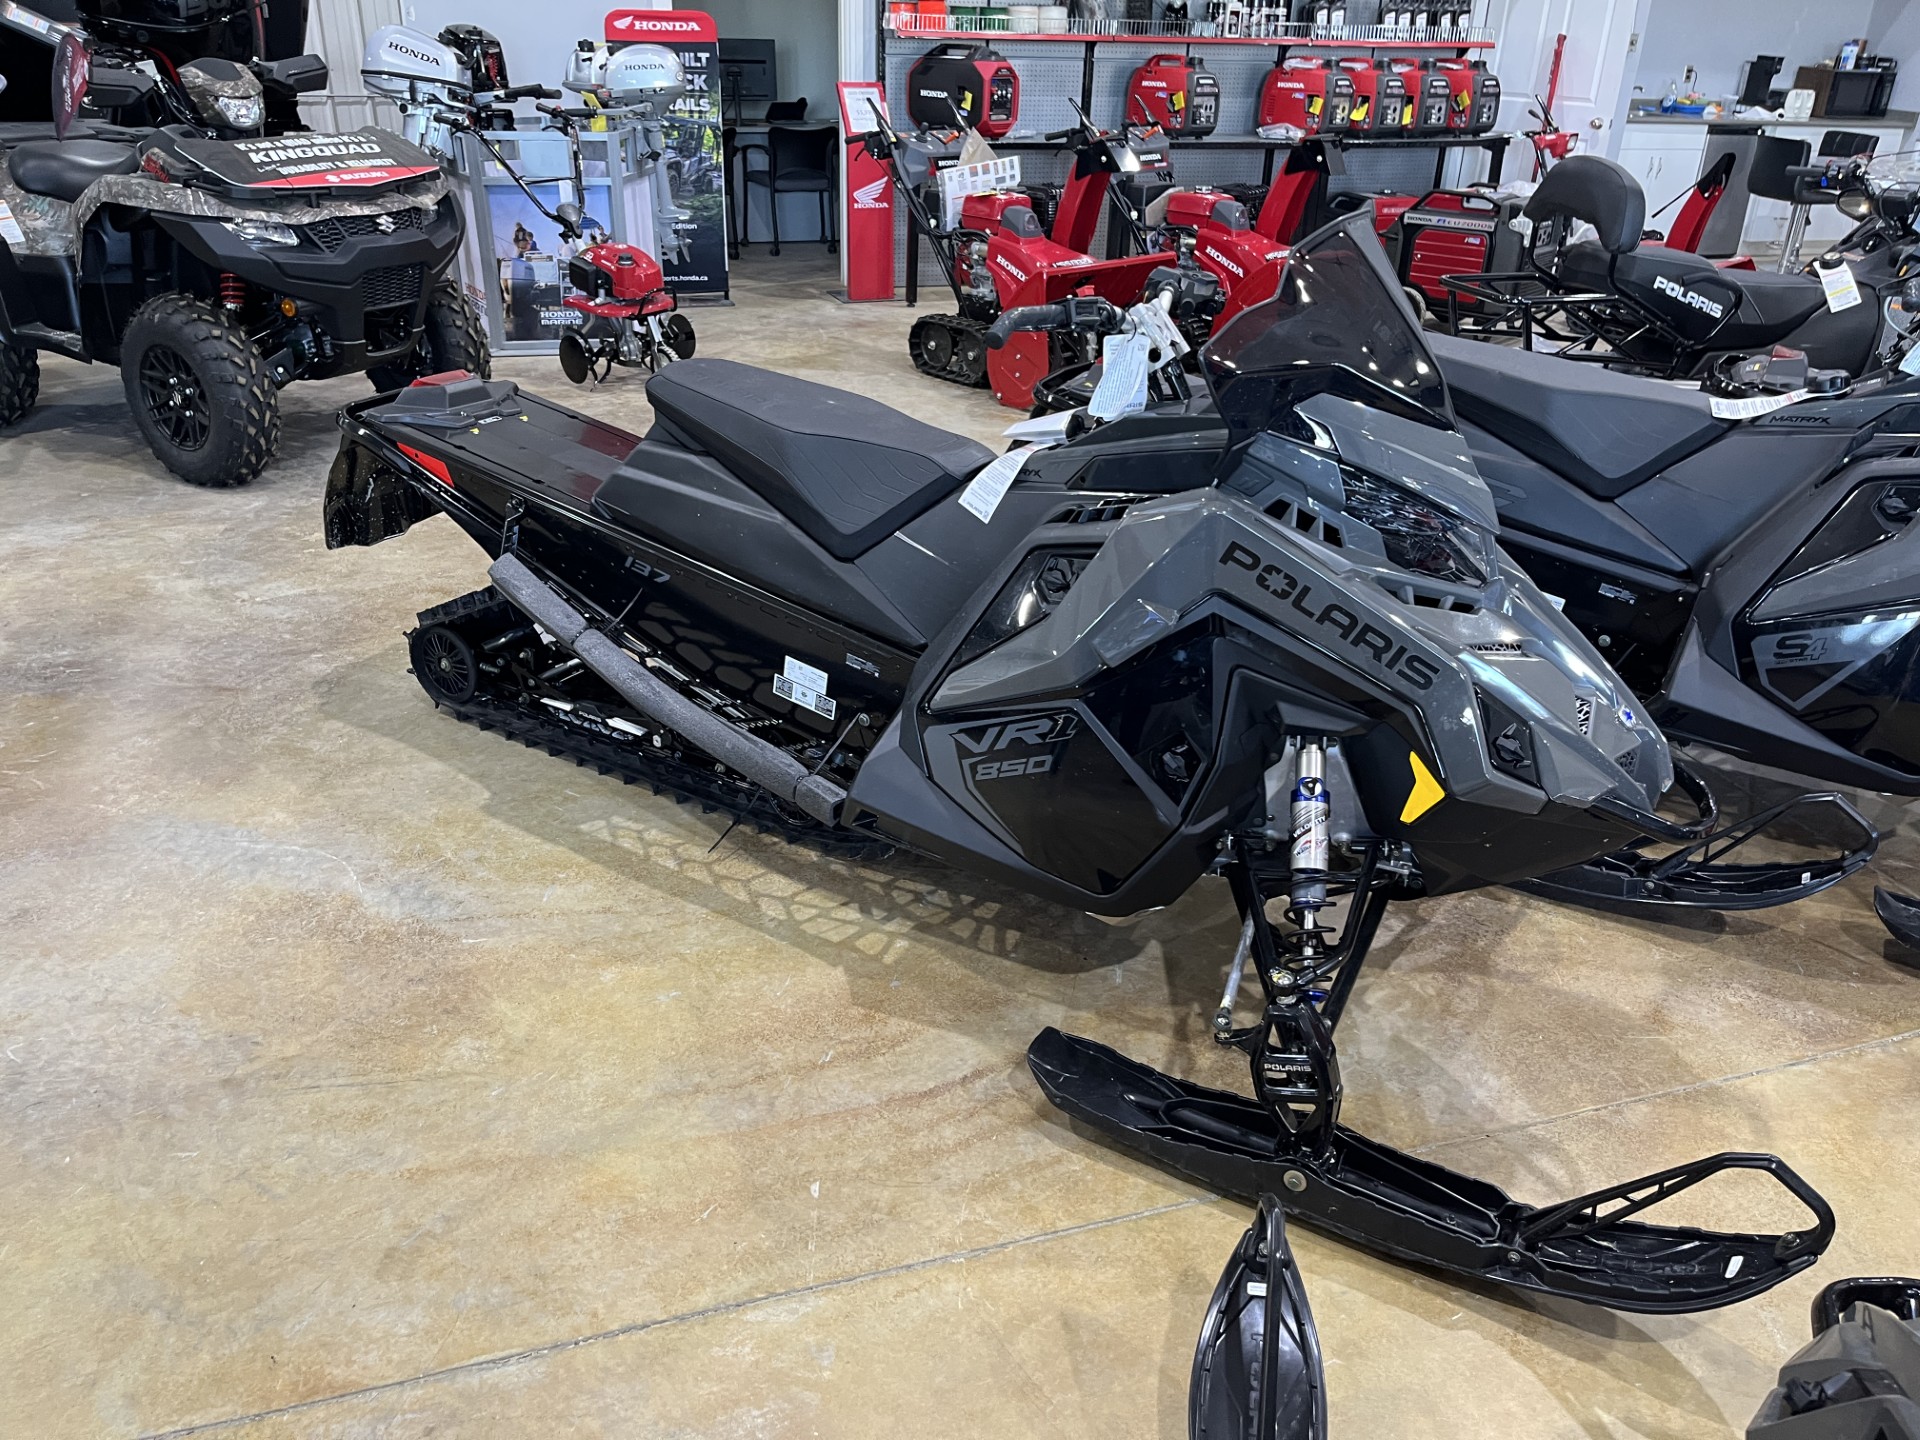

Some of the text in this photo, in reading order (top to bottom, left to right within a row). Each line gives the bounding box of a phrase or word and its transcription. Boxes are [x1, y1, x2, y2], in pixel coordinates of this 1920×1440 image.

[634, 21, 701, 31] HONDA
[388, 41, 441, 66] HONDA
[686, 74, 709, 91] CK
[1142, 80, 1167, 88] HONDA
[1277, 81, 1305, 89] HONDA
[248, 143, 382, 164] KINGQUAD
[1140, 153, 1162, 162] HONDA
[938, 159, 960, 168] HOND
[339, 171, 390, 181] SUZUKI
[1407, 215, 1433, 223] HONDA
[996, 254, 1027, 282] HOND
[1206, 245, 1244, 278] HONDA
[1653, 275, 1723, 319] POLARIS
[1769, 415, 1832, 425] MATRYX
[625, 556, 671, 583] 137
[1219, 540, 1441, 691] POLARIS
[1773, 633, 1828, 661] S4
[949, 714, 1079, 754] VR1
[976, 755, 1054, 780] 850
[1264, 1063, 1312, 1072] POLARIS
